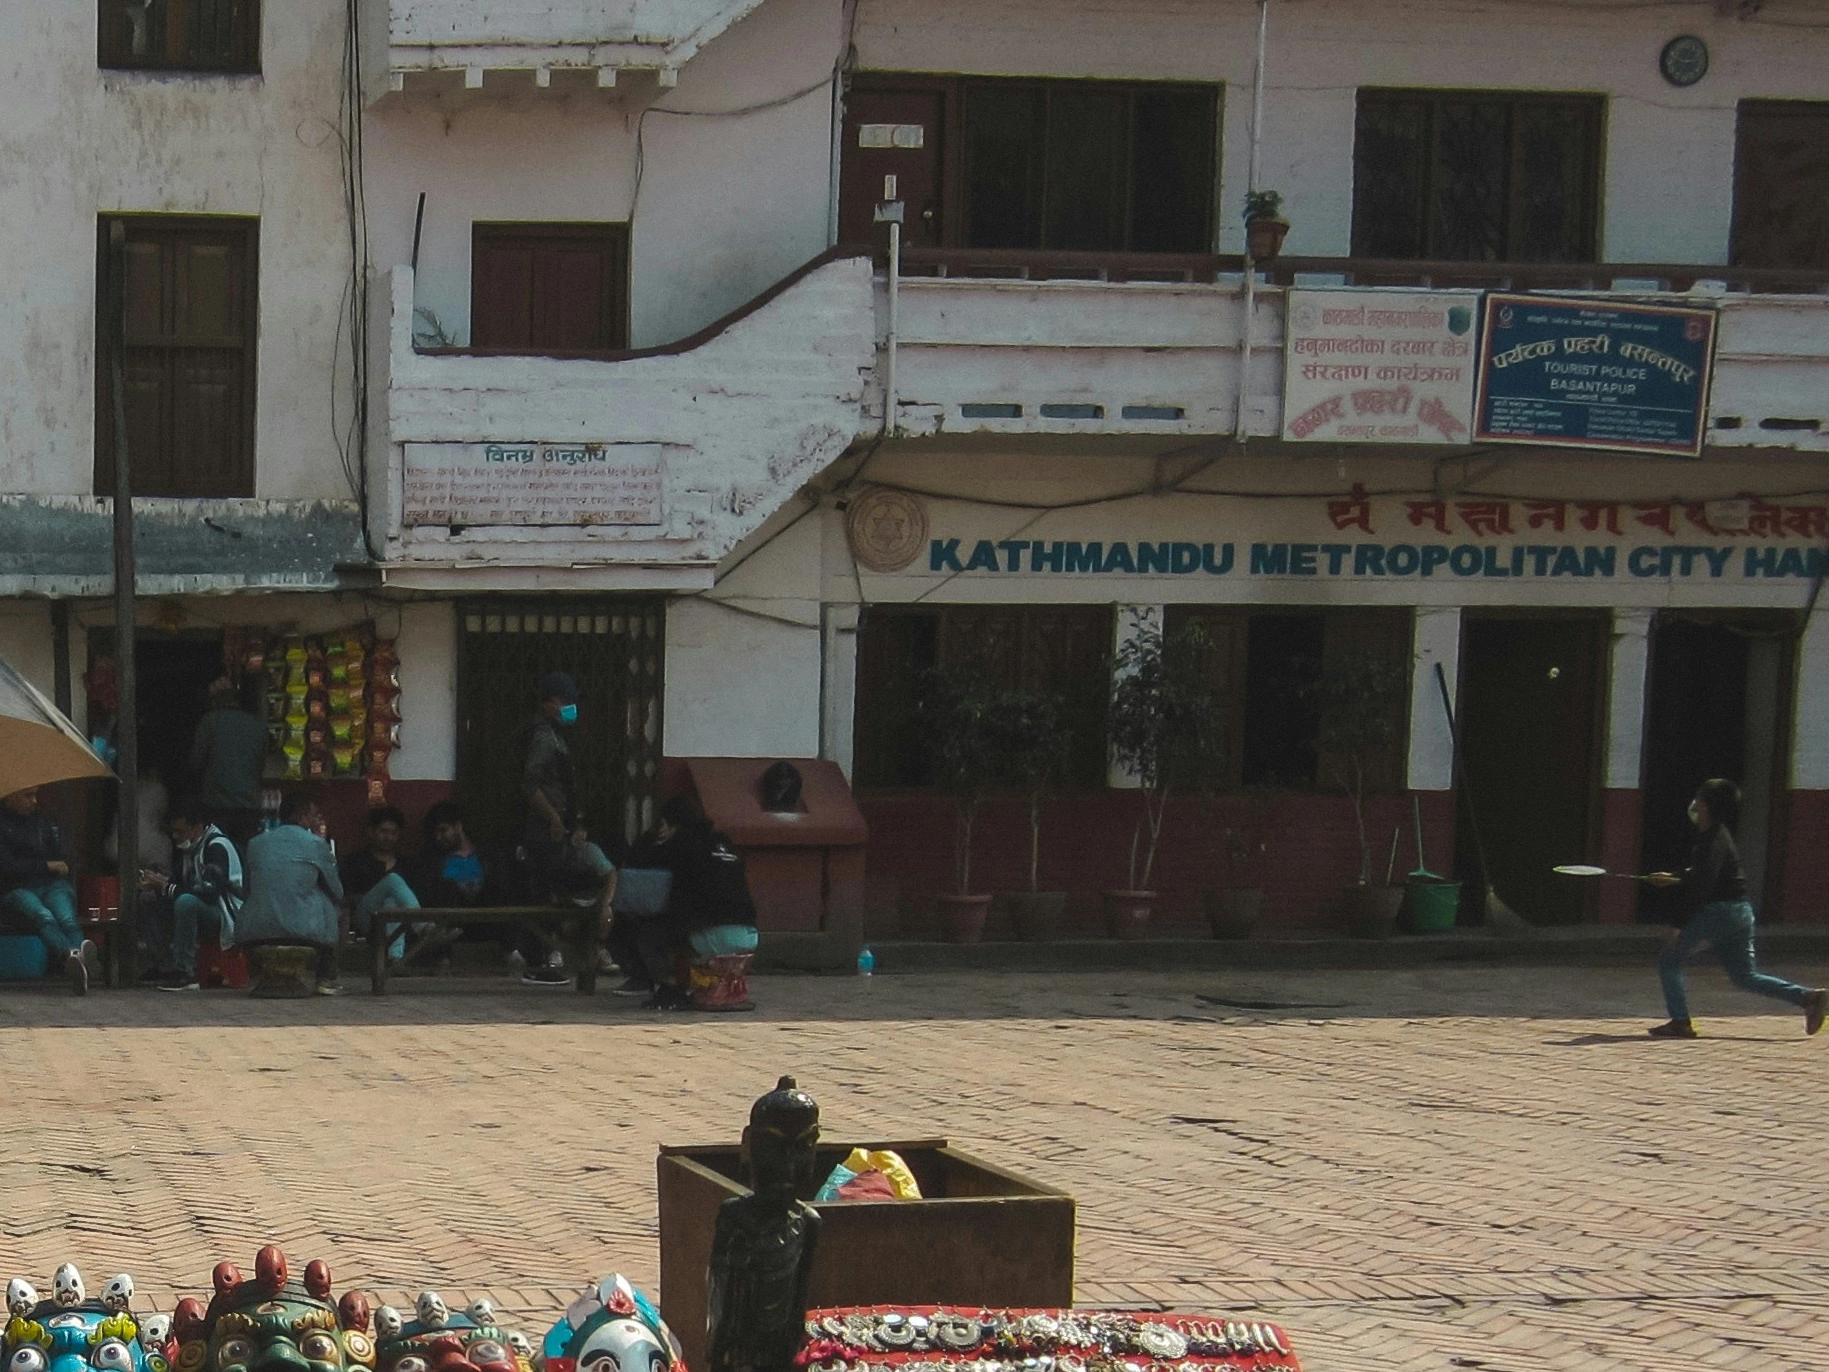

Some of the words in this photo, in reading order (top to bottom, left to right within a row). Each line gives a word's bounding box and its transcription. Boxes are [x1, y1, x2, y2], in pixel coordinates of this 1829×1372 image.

[1563, 333, 1611, 356] प्रहरी
[1544, 361, 1597, 377] TOURIST
[1600, 364, 1647, 380] POLICE
[1550, 379, 1637, 395] BASANTAPUR
[928, 538, 1235, 575] KATHMANDU
[1250, 541, 1617, 578] METROPOLITAN
[1627, 545, 1735, 578] CITY
